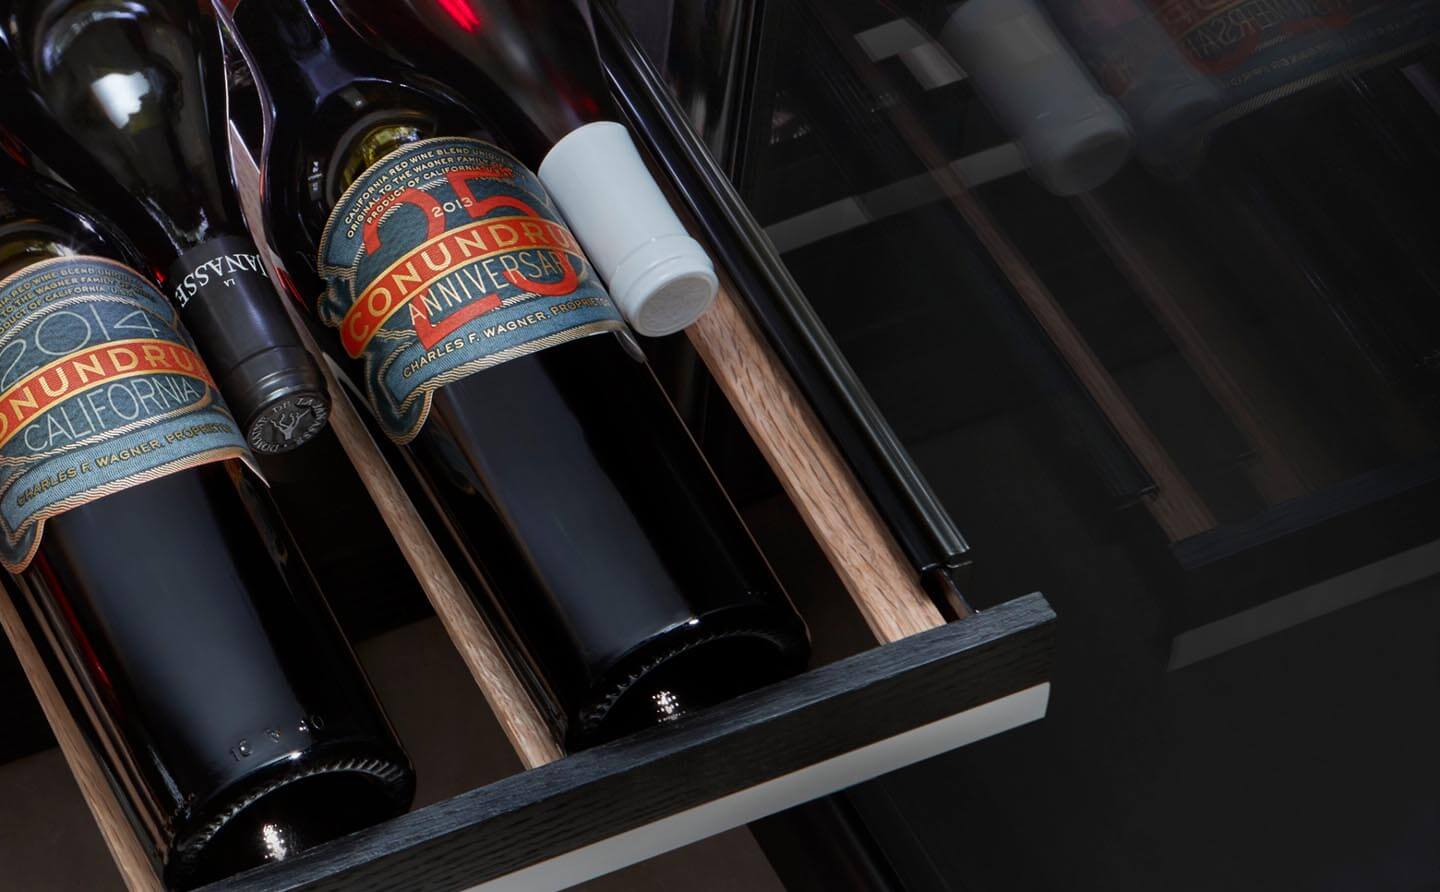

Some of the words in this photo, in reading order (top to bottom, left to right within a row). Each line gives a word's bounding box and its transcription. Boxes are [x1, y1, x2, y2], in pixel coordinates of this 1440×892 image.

[345, 175, 389, 224] CALIFORNIA
[389, 161, 408, 176] RED
[410, 151, 434, 164] WINE
[436, 146, 470, 156] BLEND
[347, 196, 380, 238] ORIGINAL
[379, 184, 392, 196] TO
[392, 170, 412, 184] THE
[413, 157, 454, 173] WAGNER
[366, 185, 407, 224] PRODUCT
[407, 176, 420, 188] OF
[431, 196, 474, 218] 2013
[1, 304, 15, 317] TO
[14, 292, 33, 306] THE
[35, 276, 78, 294] WAGNER
[80, 276, 114, 286] FAMILY
[11, 283, 31, 298] RED
[31, 272, 58, 285] WINE
[60, 267, 95, 277] BLEND
[28, 300, 41, 311] OF
[403, 337, 464, 379] CHARLES
[468, 332, 480, 344] F.
[24, 376, 200, 451] CALIFORNIA
[17, 467, 77, 507] CHARLES
[80, 462, 92, 473] F.
